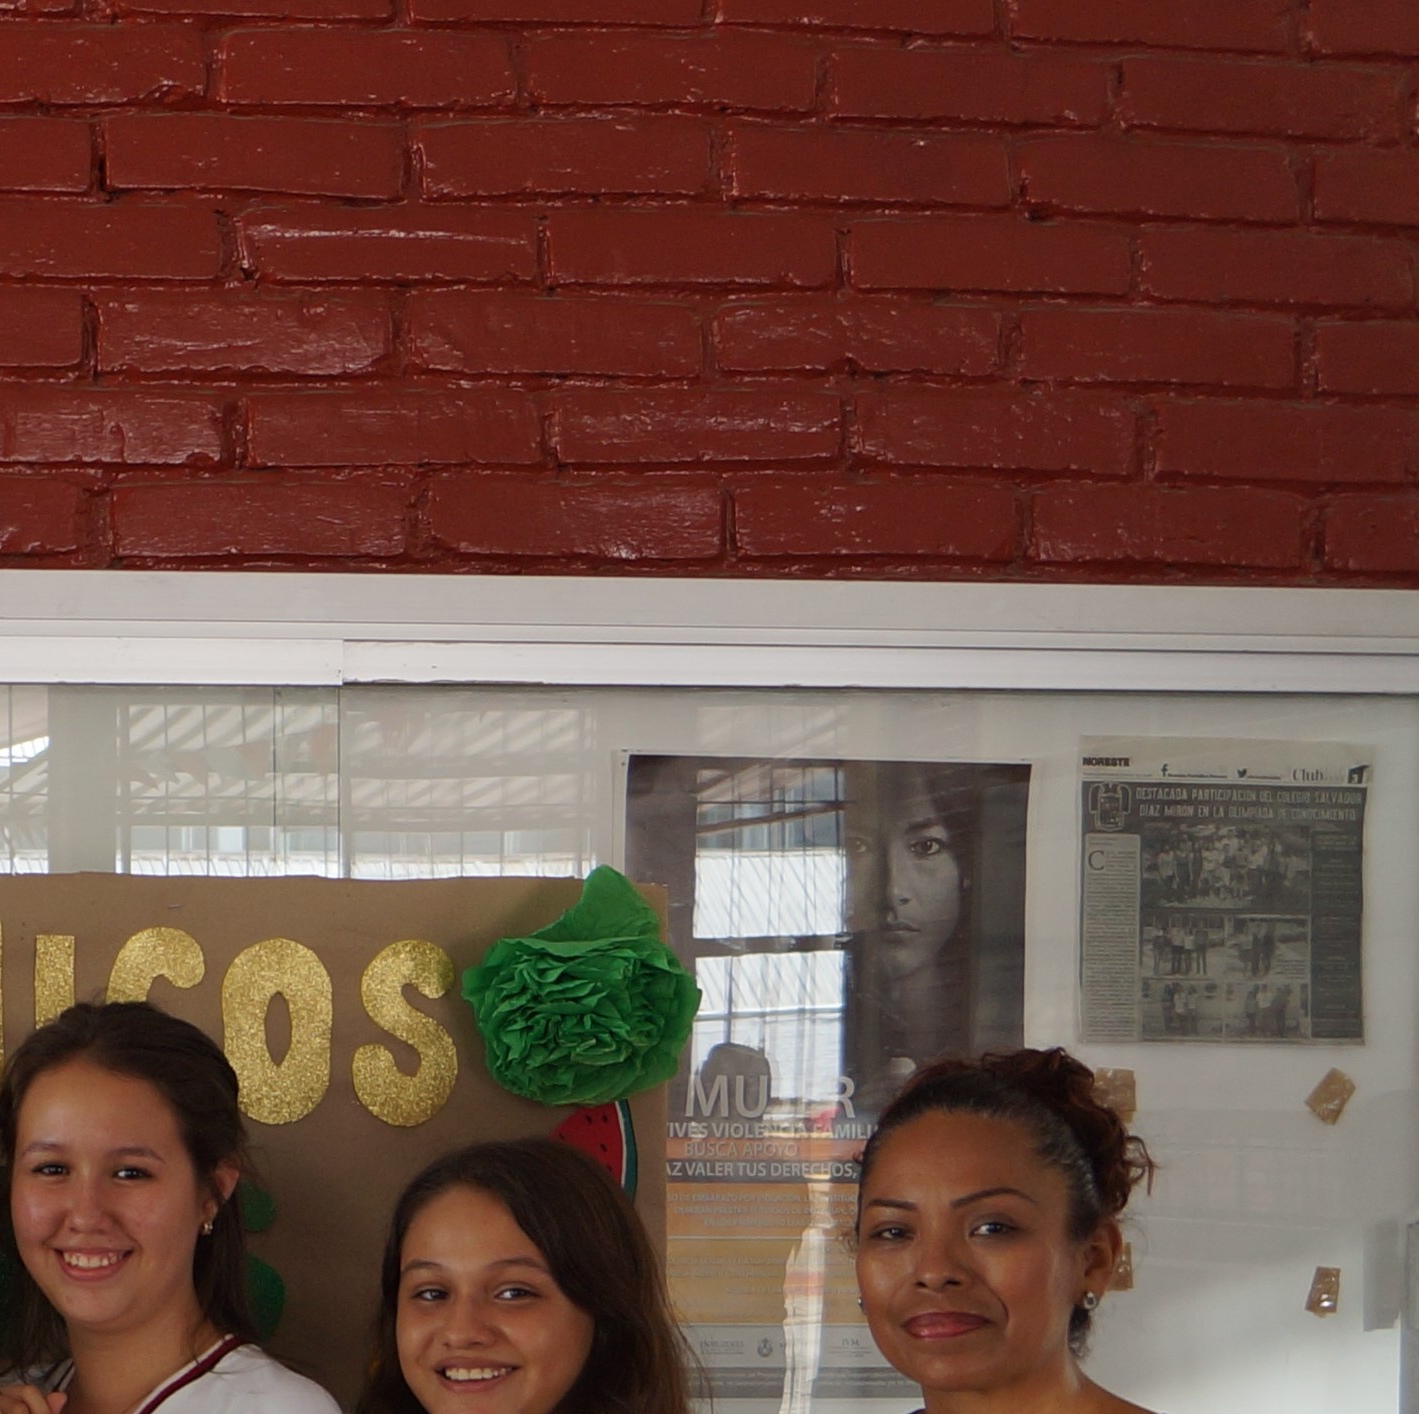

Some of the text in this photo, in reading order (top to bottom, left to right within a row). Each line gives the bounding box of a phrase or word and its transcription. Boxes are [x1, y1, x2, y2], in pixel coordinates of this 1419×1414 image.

[1083, 757, 1130, 767] NORESTE
[1136, 788, 1187, 800] DESTACADA
[1277, 791, 1311, 803] COLEGIO
[1315, 792, 1362, 804] SALVADOR
[1198, 806, 1209, 817] EN
[1213, 806, 1224, 818] LA
[684, 1075, 856, 1118] MUR
[666, 1122, 708, 1138] IVES
[712, 1122, 806, 1138] VIOLENCIA
[685, 1141, 799, 1157] BUSCA APOYO
[685, 1161, 734, 1176] VALER
[738, 1161, 766, 1177] TUS
